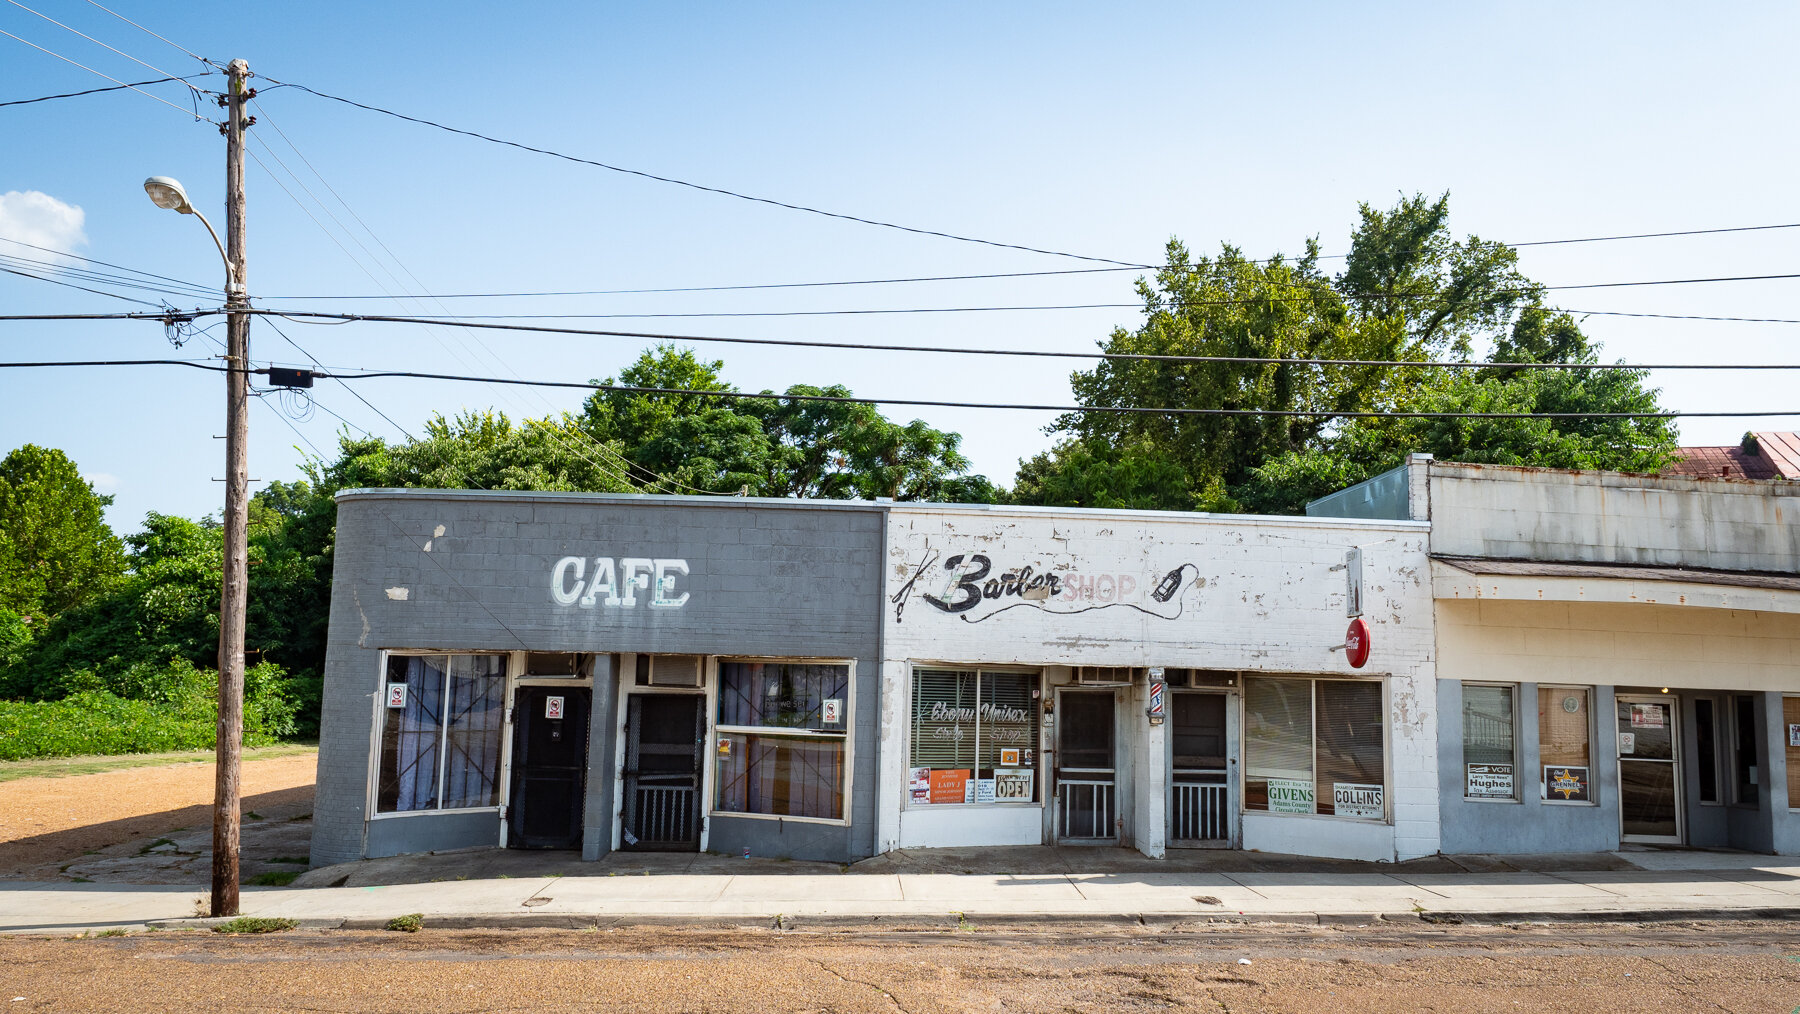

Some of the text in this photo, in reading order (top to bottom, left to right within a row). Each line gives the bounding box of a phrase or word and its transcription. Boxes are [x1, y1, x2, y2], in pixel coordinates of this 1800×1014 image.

[551, 556, 690, 608] CAFE
[923, 554, 1137, 612] Barber SHOP
[931, 701, 1028, 724] Ebony Unisex
[998, 781, 1029, 797] OPEN
[1470, 779, 1512, 789] Hughes
[1269, 787, 1314, 802] GIVENS
[1335, 790, 1382, 805] COLLINS
[1291, 801, 1311, 809] County
